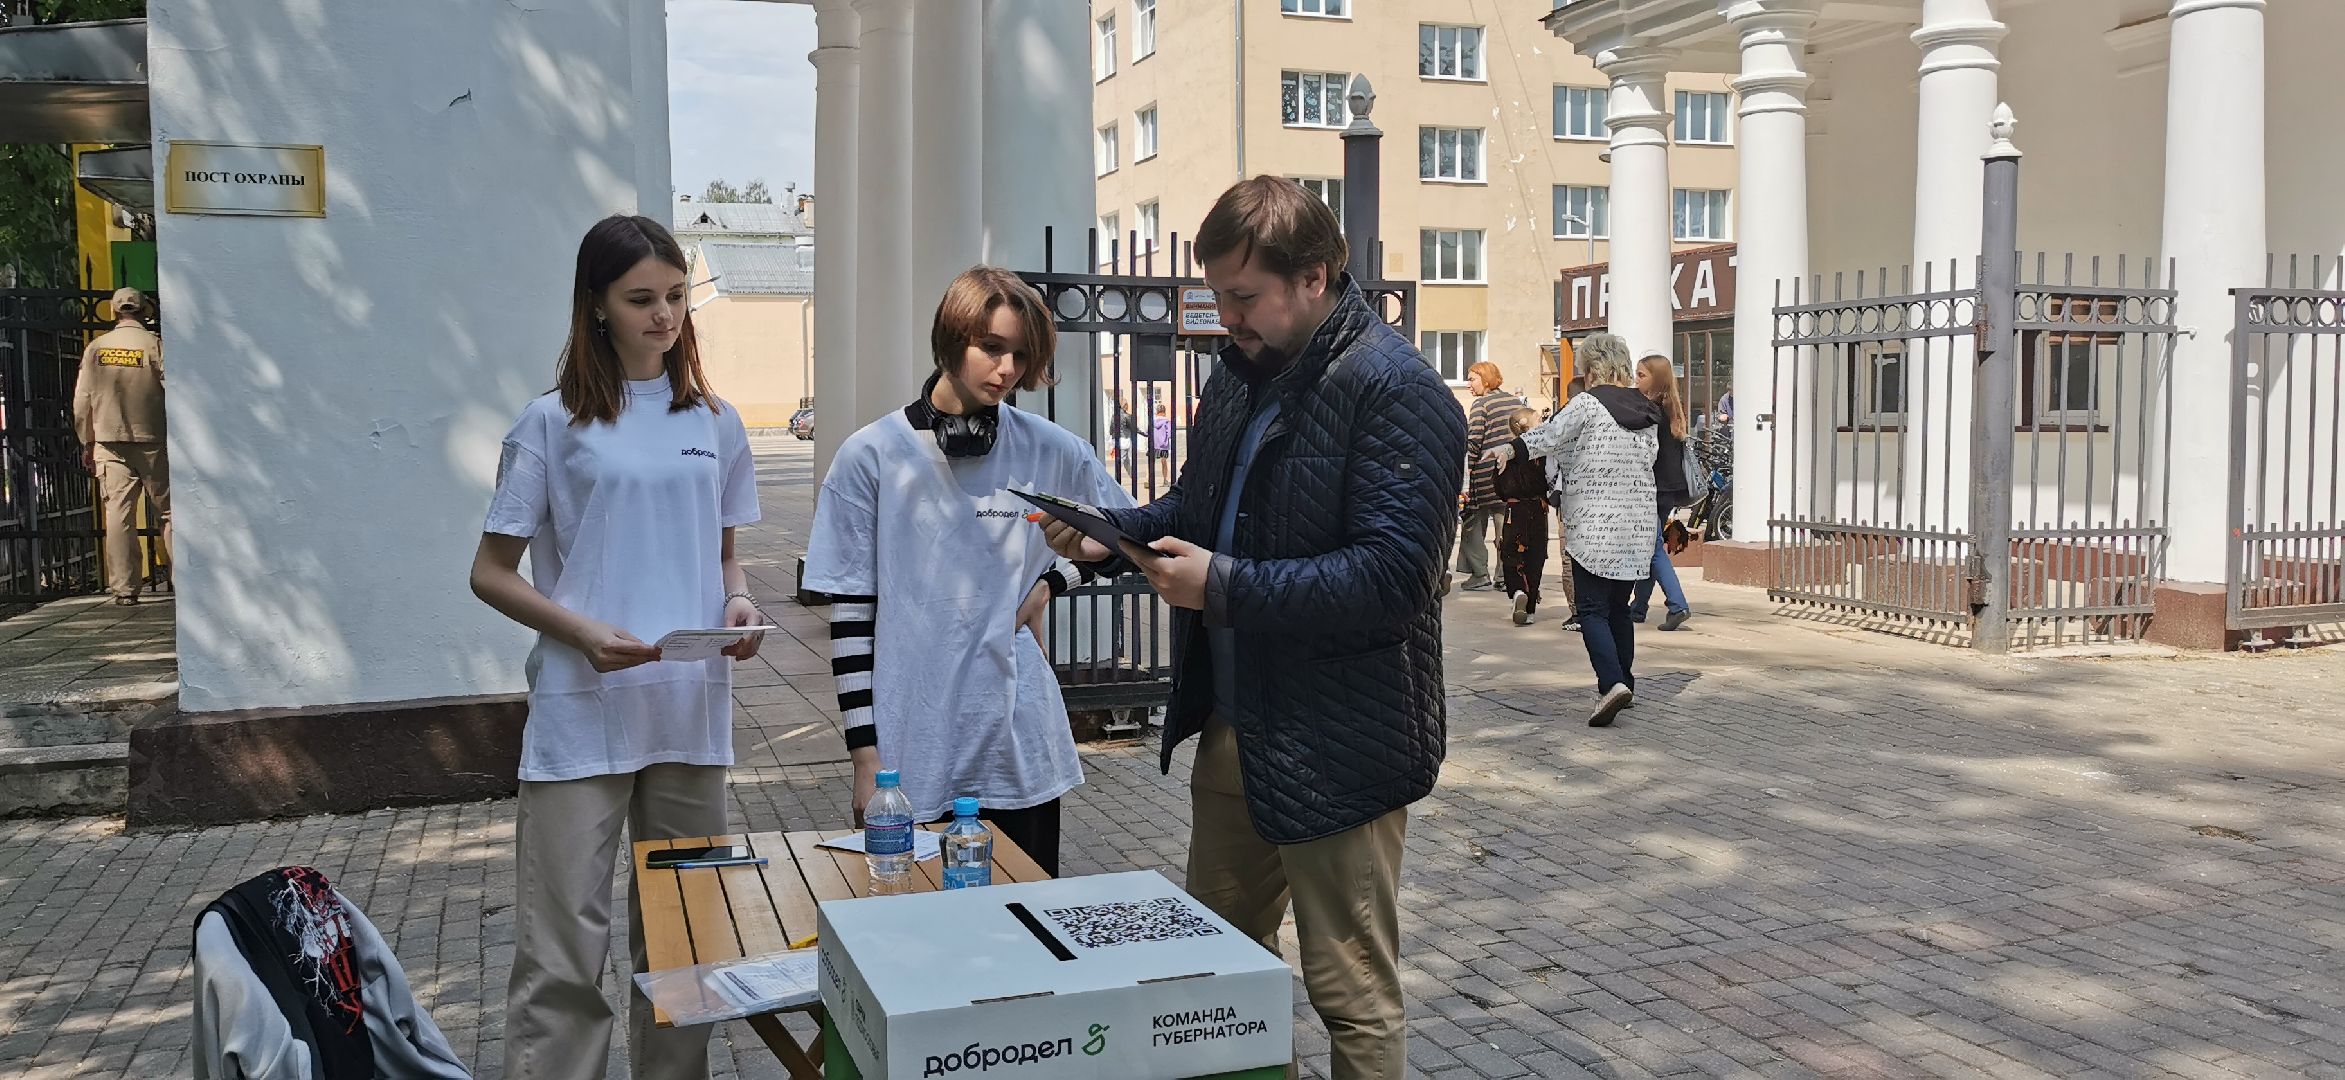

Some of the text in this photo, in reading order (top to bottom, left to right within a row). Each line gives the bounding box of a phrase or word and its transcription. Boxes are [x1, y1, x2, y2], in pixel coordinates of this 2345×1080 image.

[185, 170, 305, 186] ПОСТ ОХРАНЫ
[98, 349, 144, 358] РУССКАЯ
[101, 357, 138, 366] ОХРАНА
[1571, 462, 1620, 475] Change
[1586, 480, 1618, 488] Change
[975, 508, 1019, 518] добродел
[1571, 507, 1621, 522] Change
[1586, 525, 1618, 533] Change
[1576, 532, 1606, 541] Change
[1152, 1006, 1237, 1029] КОМАНДА
[1152, 1020, 1267, 1047] ГУБЕРНАТОРА
[924, 1037, 1073, 1078] добродел
